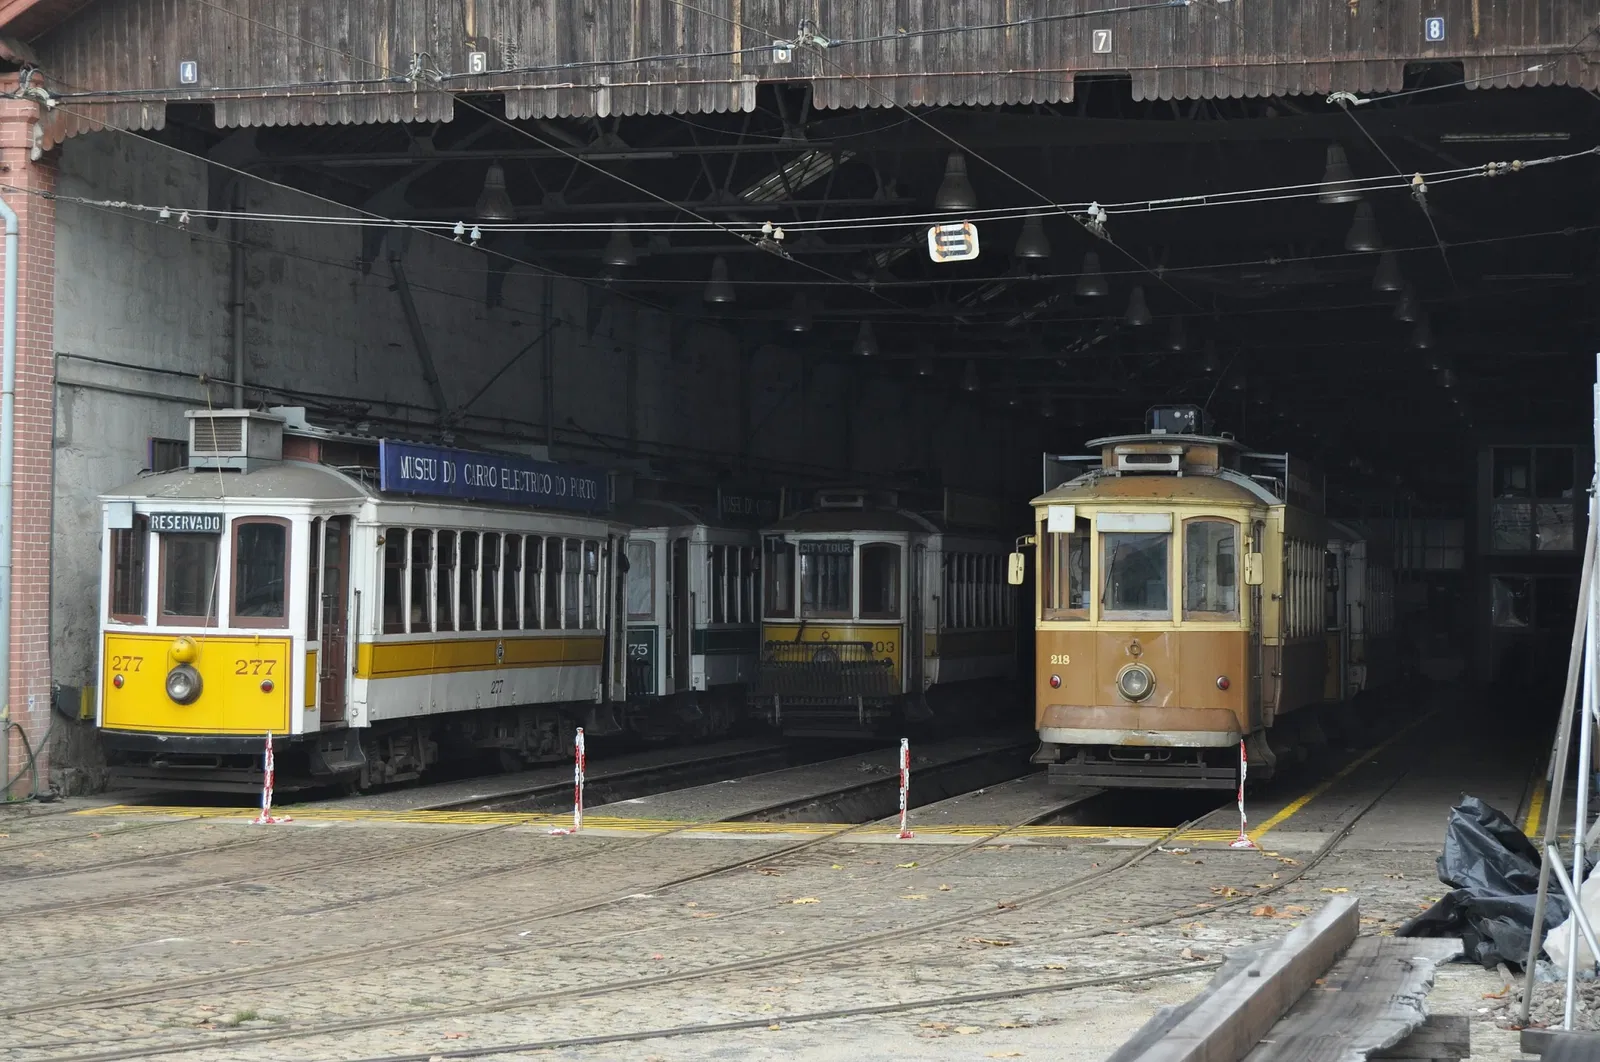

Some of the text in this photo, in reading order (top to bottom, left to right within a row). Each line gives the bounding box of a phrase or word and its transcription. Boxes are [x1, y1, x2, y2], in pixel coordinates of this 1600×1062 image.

[1430, 20, 1440, 38] 8
[1098, 32, 1106, 50] 7
[473, 55, 482, 71] 5
[184, 64, 193, 80] 4
[400, 456, 597, 500] MUSEU DO CARRO ELECTRICO DO PORTO
[151, 515, 220, 530] RESERVADO
[800, 543, 850, 553] CITY TOUR
[869, 641, 895, 653] 03
[112, 656, 143, 672] 277
[235, 659, 277, 675] 277
[1050, 654, 1070, 665] 218
[490, 680, 504, 694] 277
